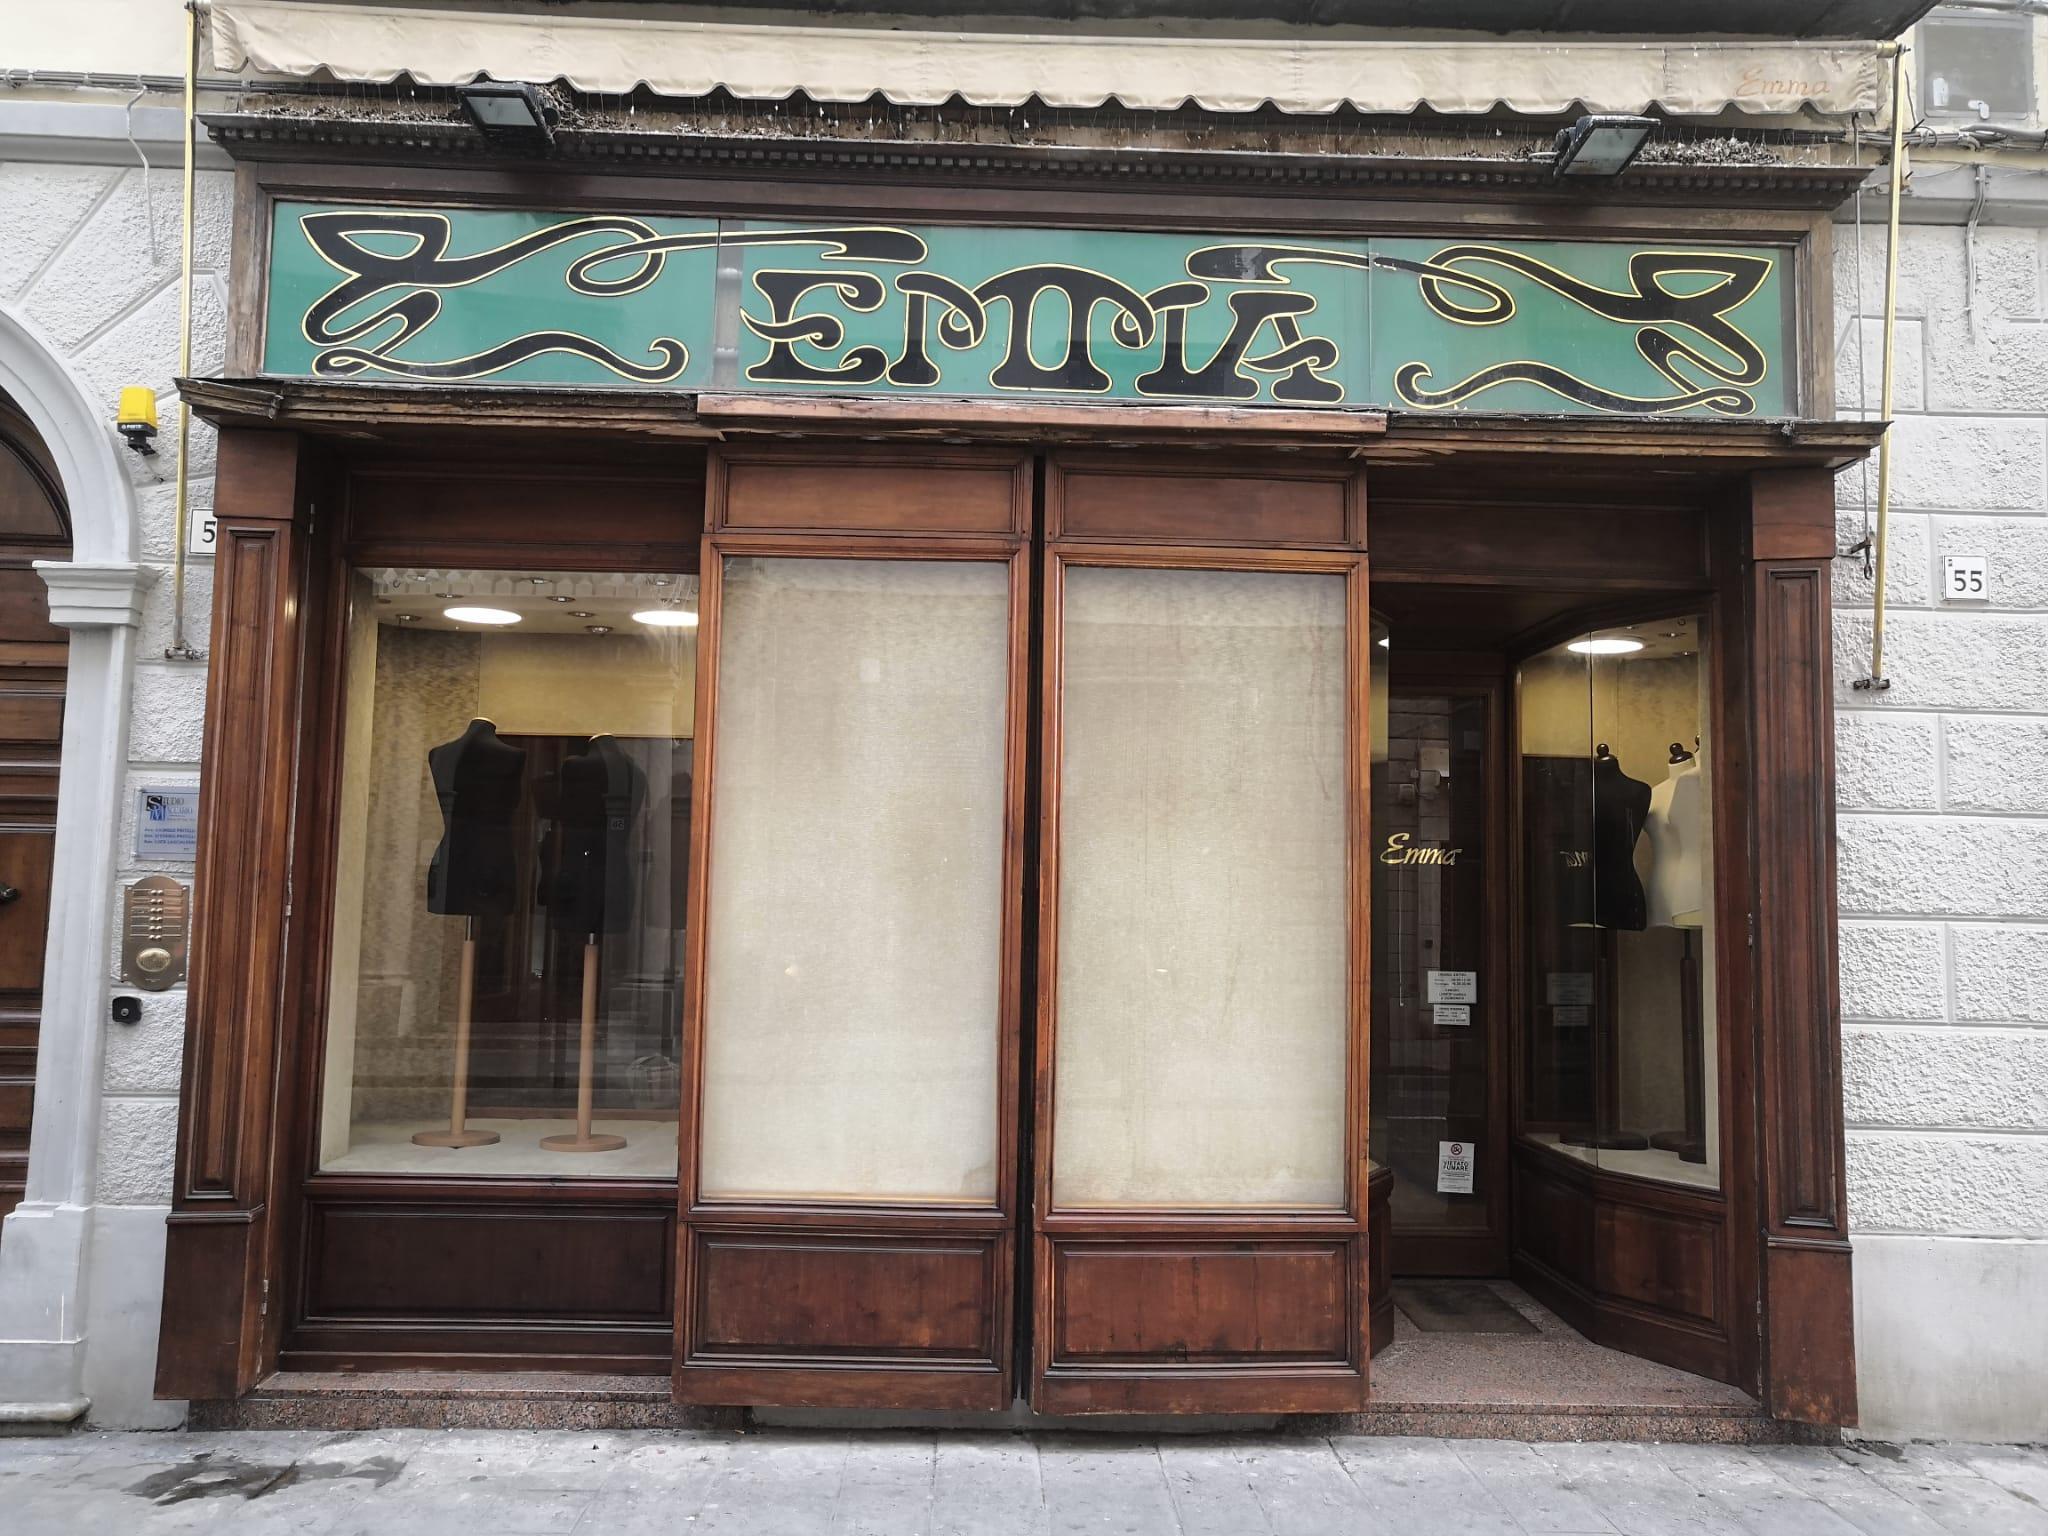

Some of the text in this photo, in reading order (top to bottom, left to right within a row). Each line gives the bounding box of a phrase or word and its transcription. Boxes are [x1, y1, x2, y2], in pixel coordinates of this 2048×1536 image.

[1735, 65, 1831, 97] Emma
[739, 263, 1345, 403] EMMA
[1954, 569, 1982, 592] 55
[1380, 832, 1463, 866] Emma
